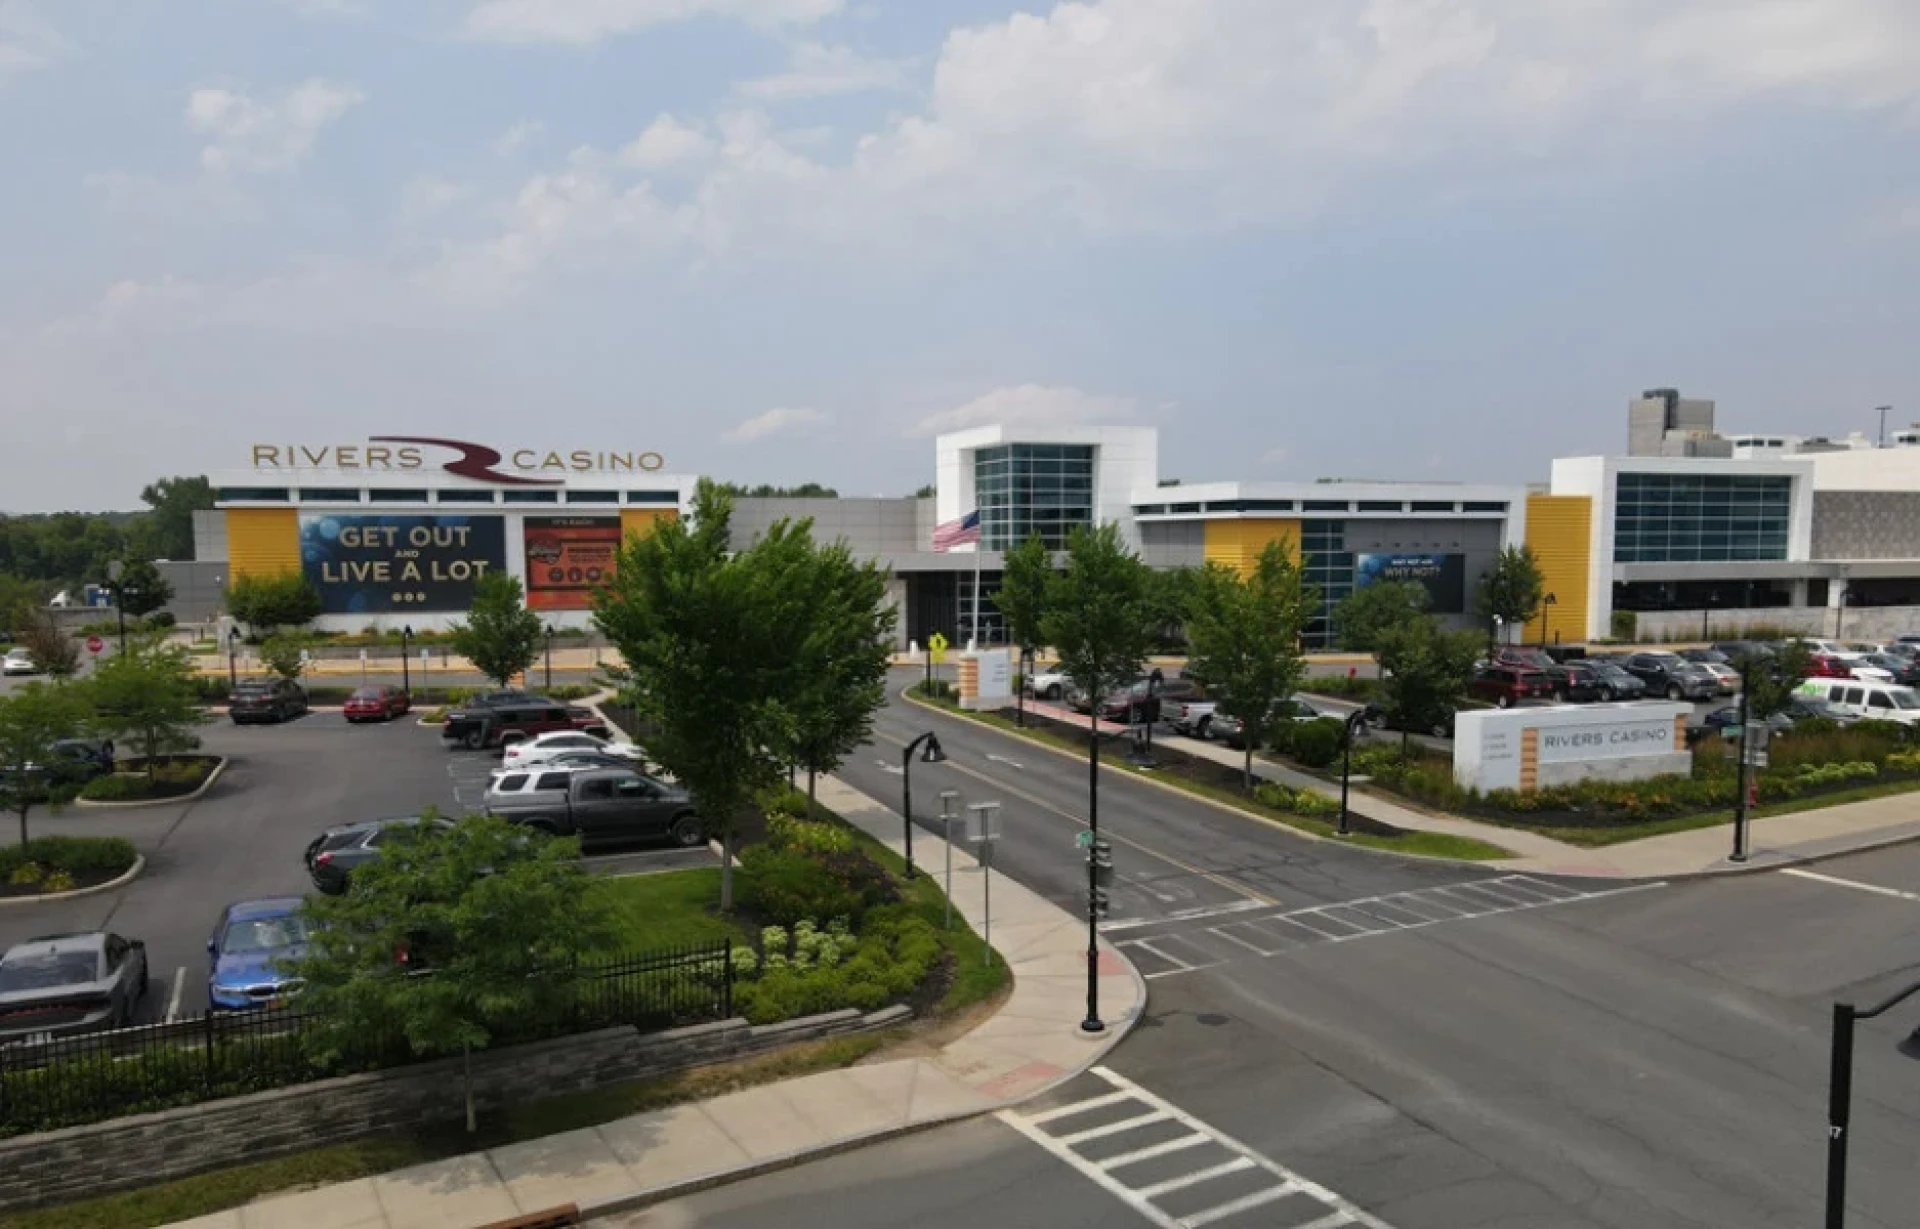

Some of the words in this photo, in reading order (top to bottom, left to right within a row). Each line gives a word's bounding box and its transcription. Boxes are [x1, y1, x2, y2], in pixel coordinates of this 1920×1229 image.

[253, 444, 424, 468] RIVERS
[512, 449, 665, 471] CASINO
[339, 526, 399, 547] GET
[409, 526, 471, 546] OUT
[395, 549, 419, 558] AND
[322, 561, 391, 583] LIVE
[402, 561, 421, 582] A
[432, 560, 489, 581] LOT
[1545, 733, 1603, 747] RIVERS
[1610, 729, 1667, 744] CASINO
